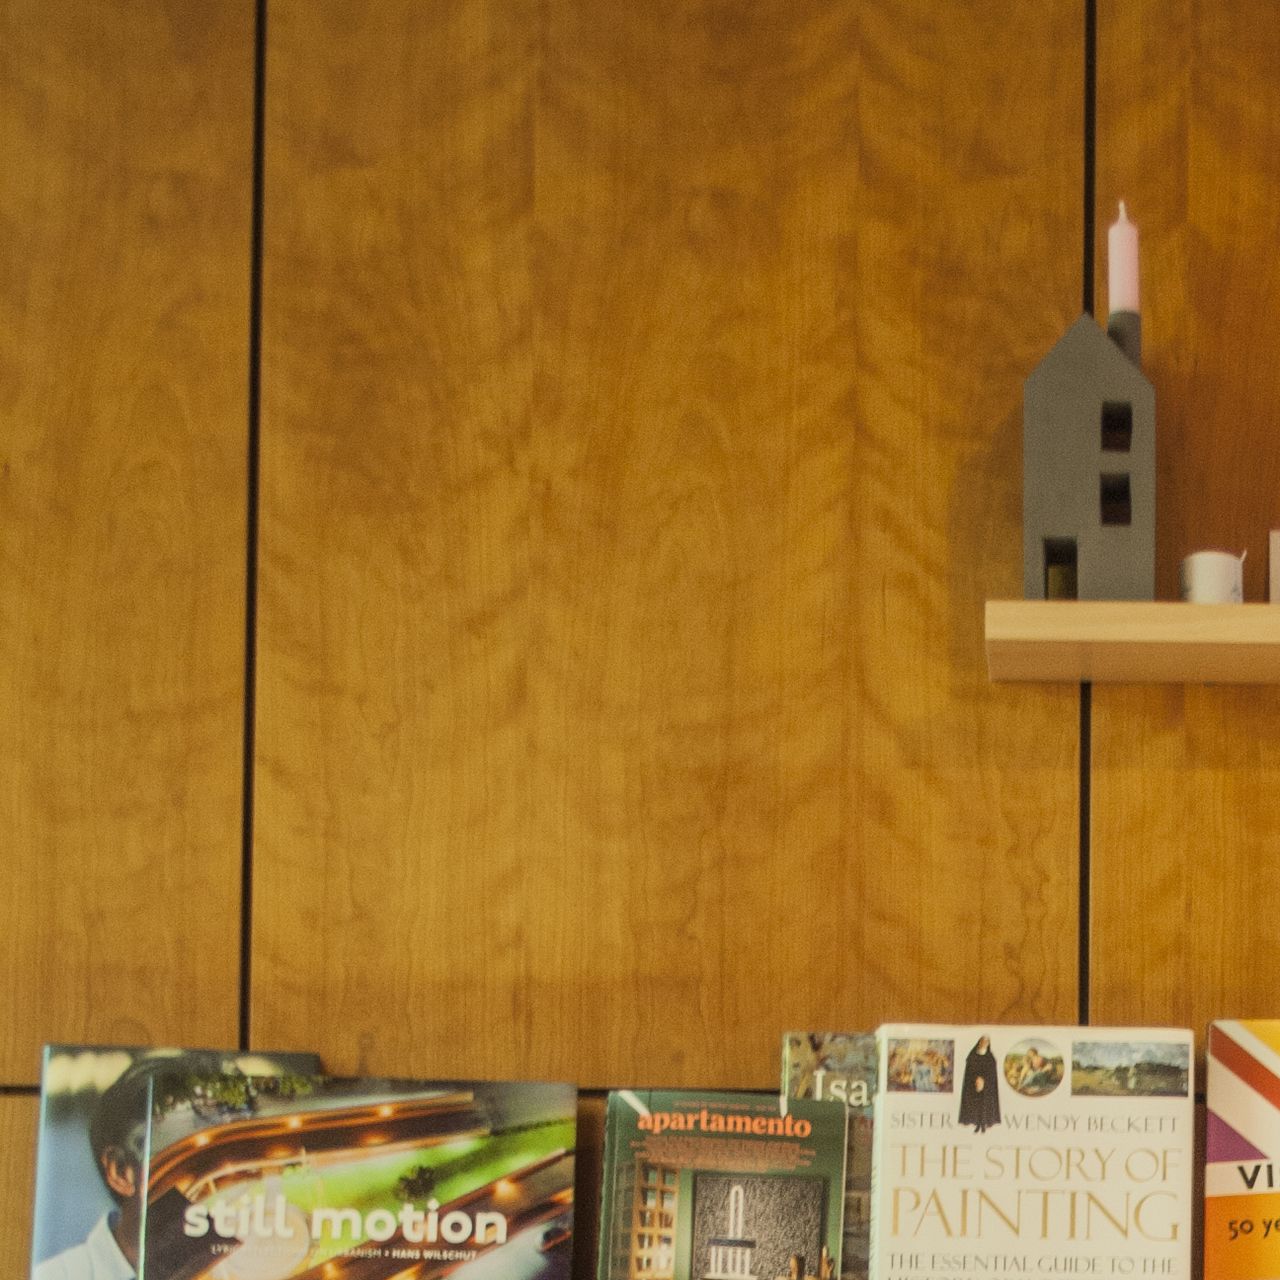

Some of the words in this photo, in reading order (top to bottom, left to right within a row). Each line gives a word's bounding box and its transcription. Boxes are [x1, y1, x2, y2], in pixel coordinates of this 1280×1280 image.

[637, 1108, 812, 1138] apartamento
[889, 1111, 953, 1130] SISTER
[1003, 1114, 1081, 1132] WENDY
[1086, 1115, 1179, 1134] BECKETT
[891, 1143, 974, 1180] THE
[984, 1144, 1117, 1183] STORY
[1123, 1147, 1183, 1184] OF
[183, 1194, 294, 1239] still
[311, 1198, 507, 1244] motion
[888, 1187, 1181, 1242] PAINTING
[1228, 1218, 1254, 1241] 50
[888, 1253, 925, 1272] THE
[930, 1253, 1034, 1273] ESSENTIAL
[1036, 1255, 1099, 1275] GUIDE
[1109, 1256, 1135, 1275] TO
[1141, 1257, 1178, 1275] THE
